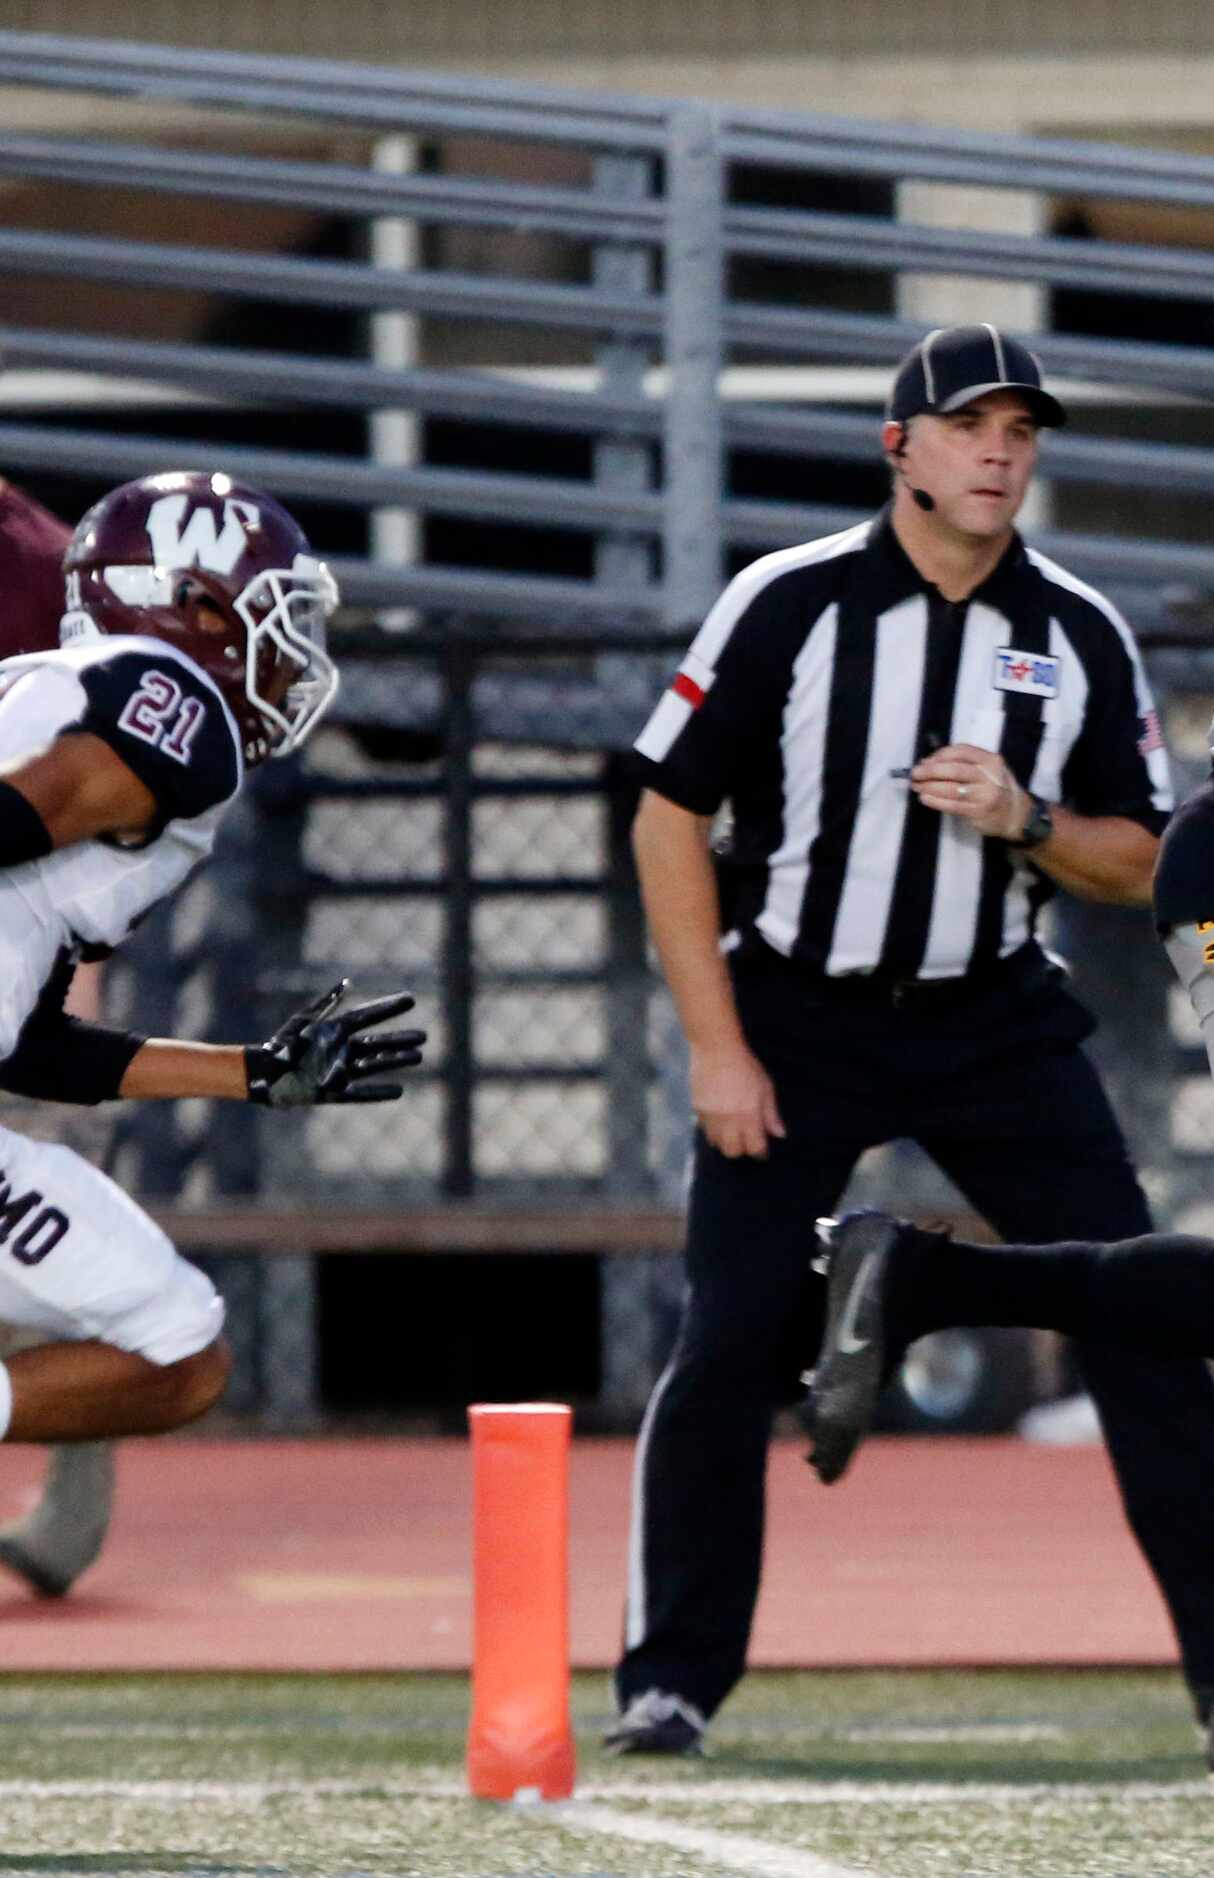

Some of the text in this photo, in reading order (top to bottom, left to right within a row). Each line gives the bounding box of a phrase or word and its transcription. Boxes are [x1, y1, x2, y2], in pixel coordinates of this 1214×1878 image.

[147, 494, 260, 576] W
[118, 670, 205, 766] 21
[0, 1169, 70, 1266] MO
